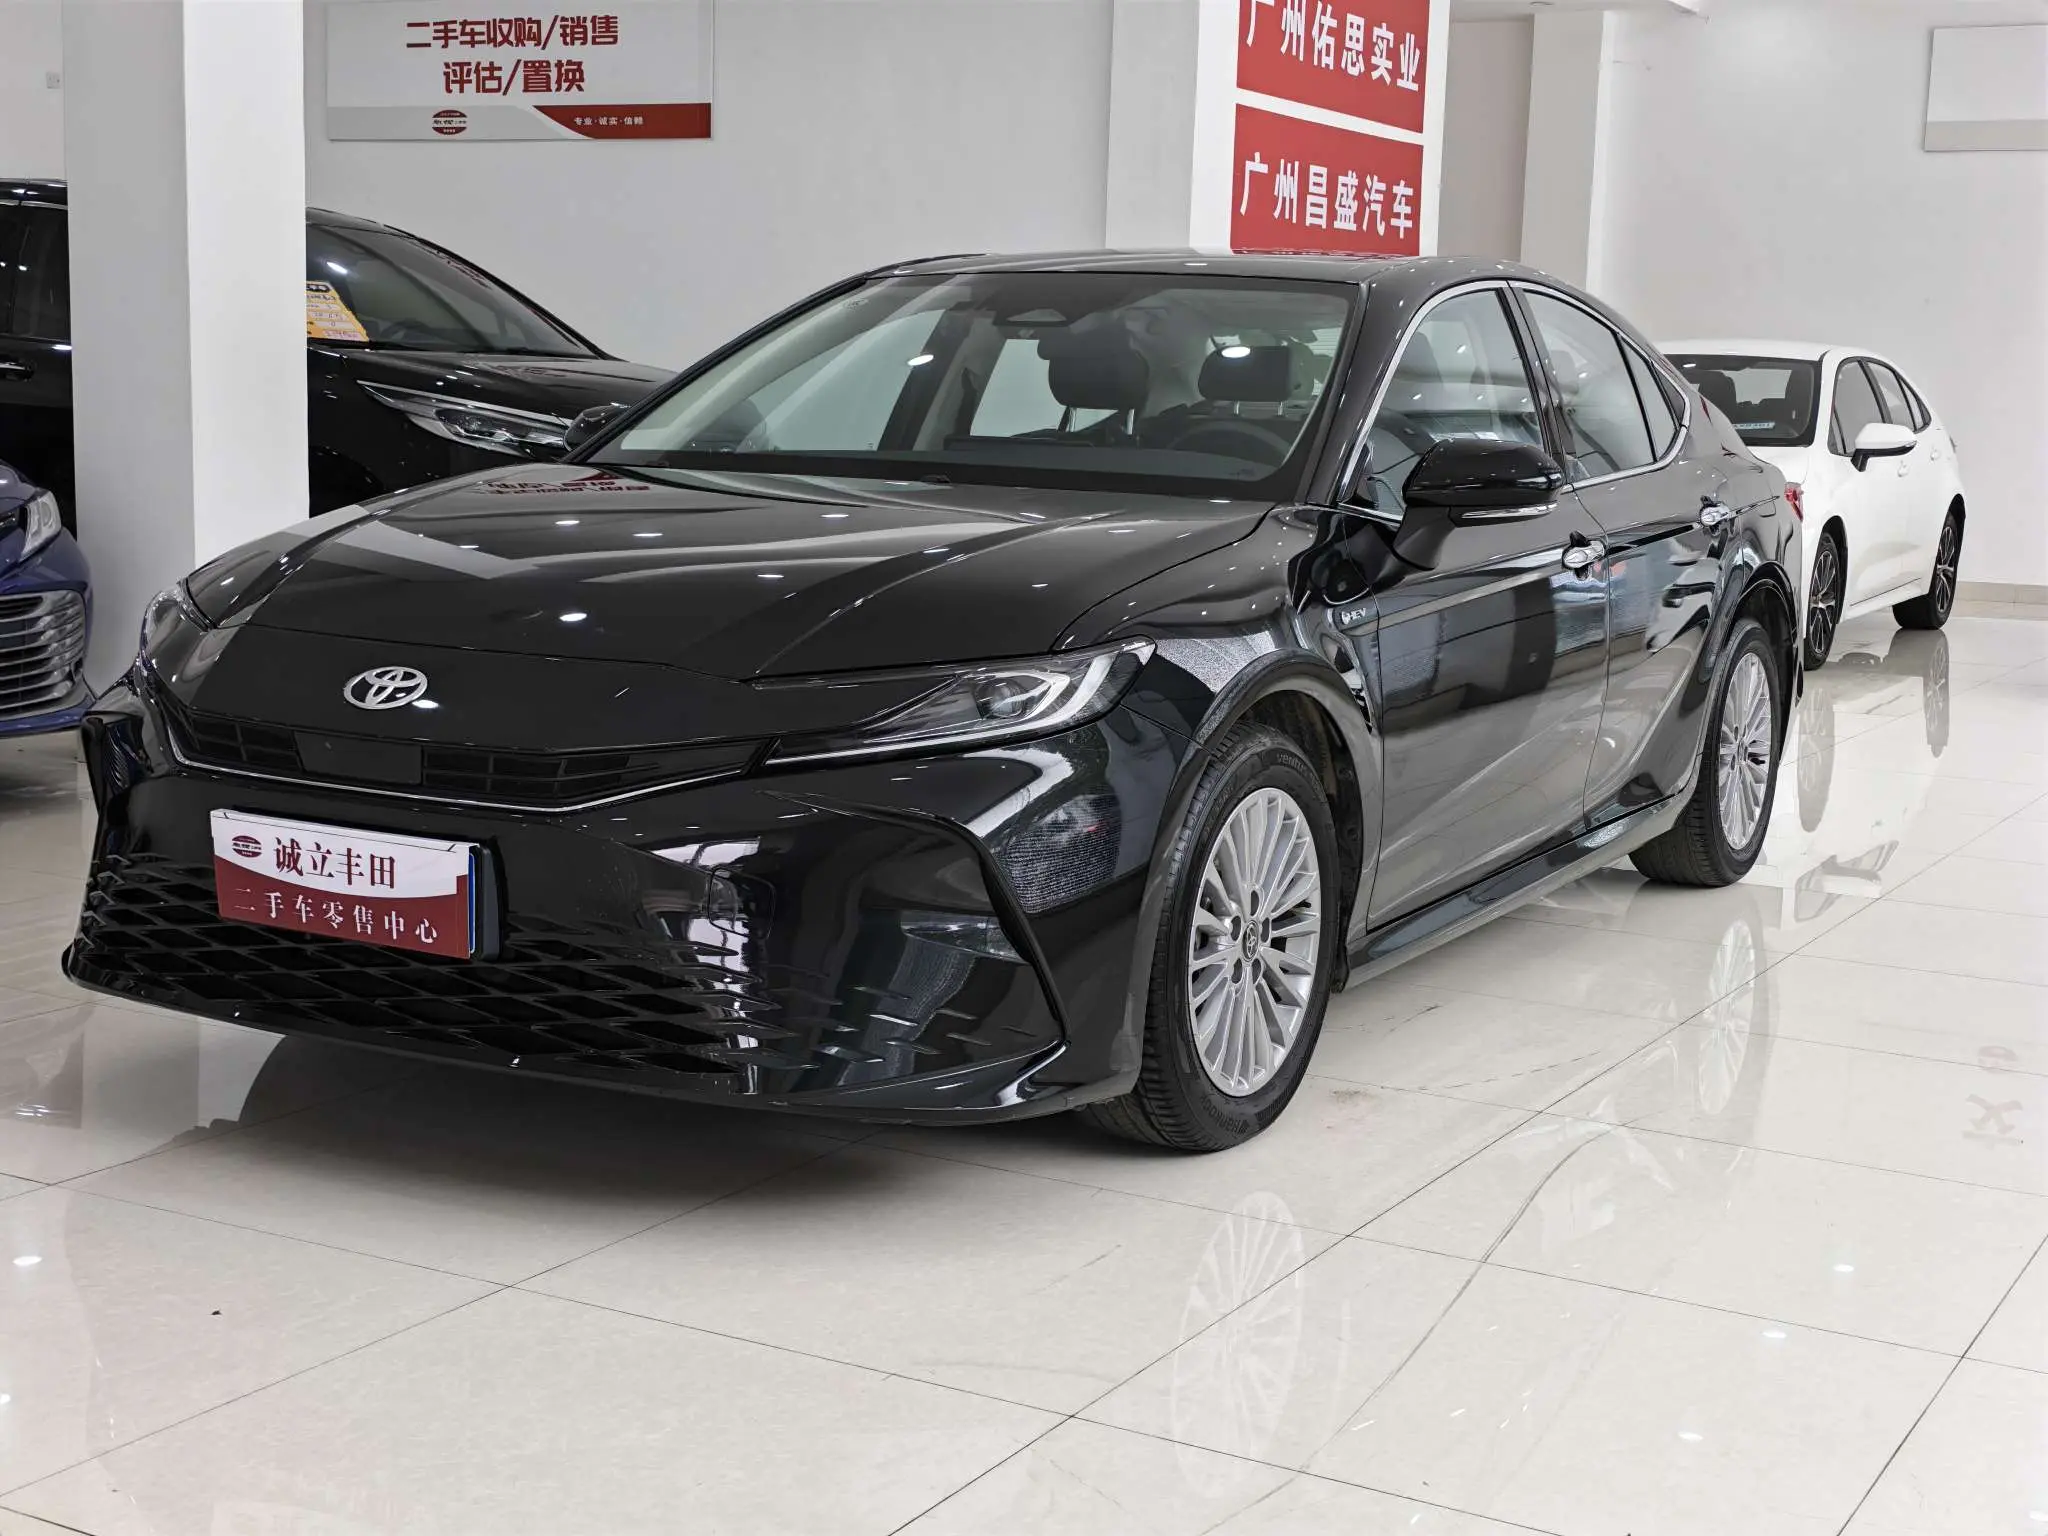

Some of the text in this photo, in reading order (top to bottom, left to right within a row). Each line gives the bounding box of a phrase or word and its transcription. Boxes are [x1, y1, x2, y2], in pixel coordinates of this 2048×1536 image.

[406, 14, 619, 50] 二手车收购/销售
[1246, 0, 1421, 92] 广州佑思实业
[442, 59, 585, 96] 评估/置换
[1239, 152, 1413, 239] 广州昌盛汽车
[274, 836, 396, 889] 诚立丰田
[233, 887, 438, 944] 二手车零售中心
